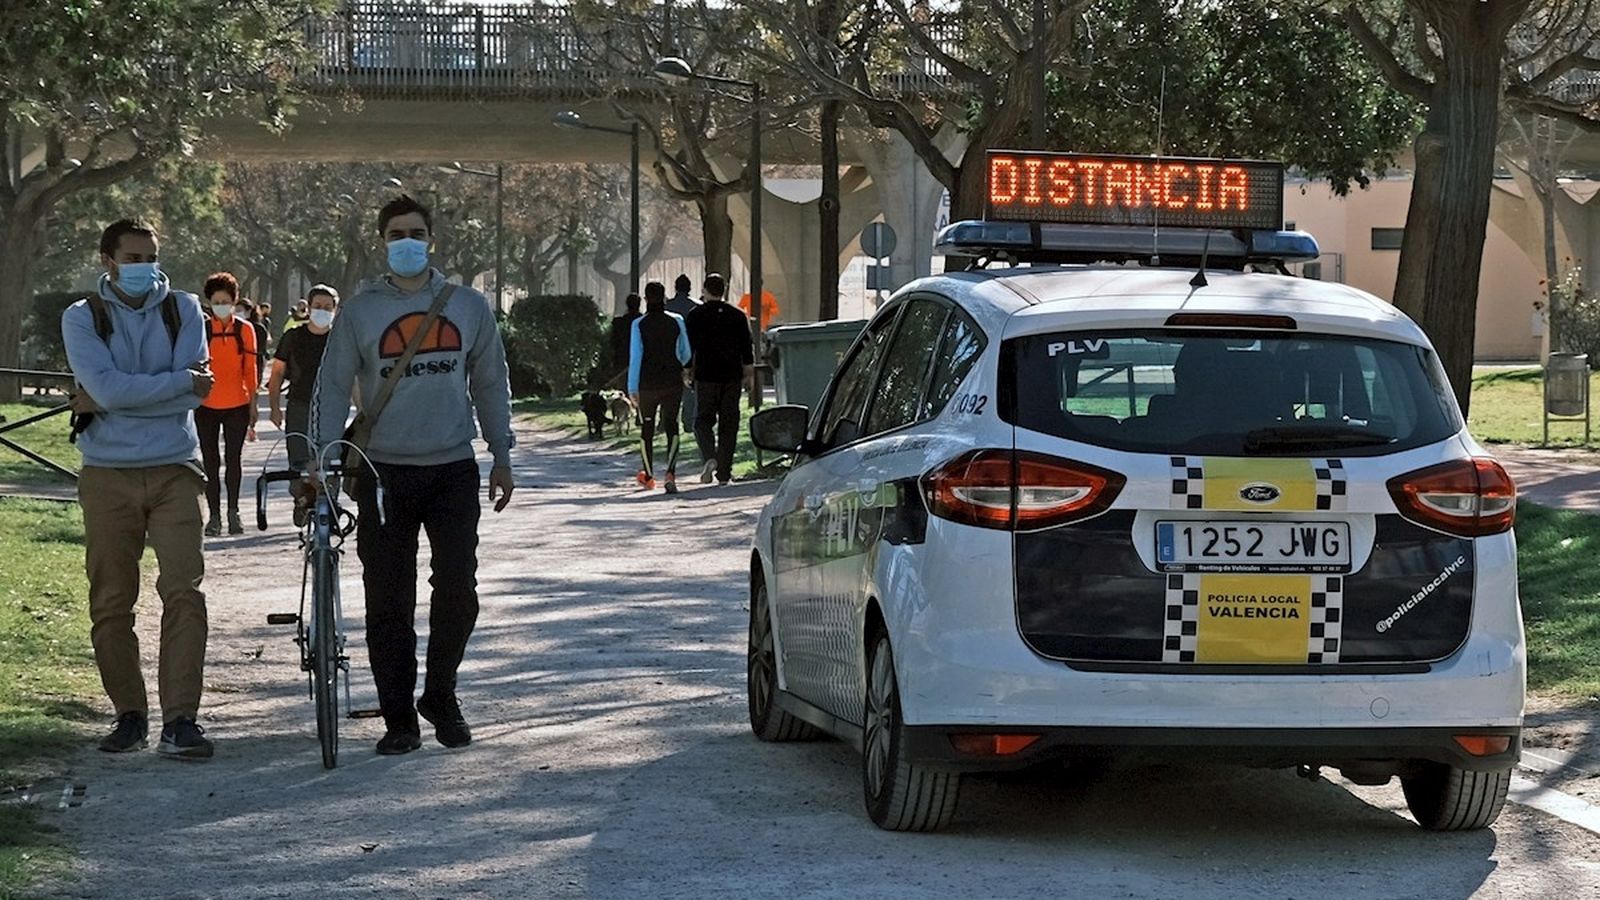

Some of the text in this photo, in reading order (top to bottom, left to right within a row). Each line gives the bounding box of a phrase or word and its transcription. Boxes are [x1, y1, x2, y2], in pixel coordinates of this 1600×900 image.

[990, 158, 1248, 211] DISTANCIA
[1048, 338, 1105, 356] PLV
[1163, 527, 1340, 557] E 1252 JWG
[1207, 594, 1301, 604] POLICIA LOCAL
[1208, 606, 1300, 619] VALENCIA
